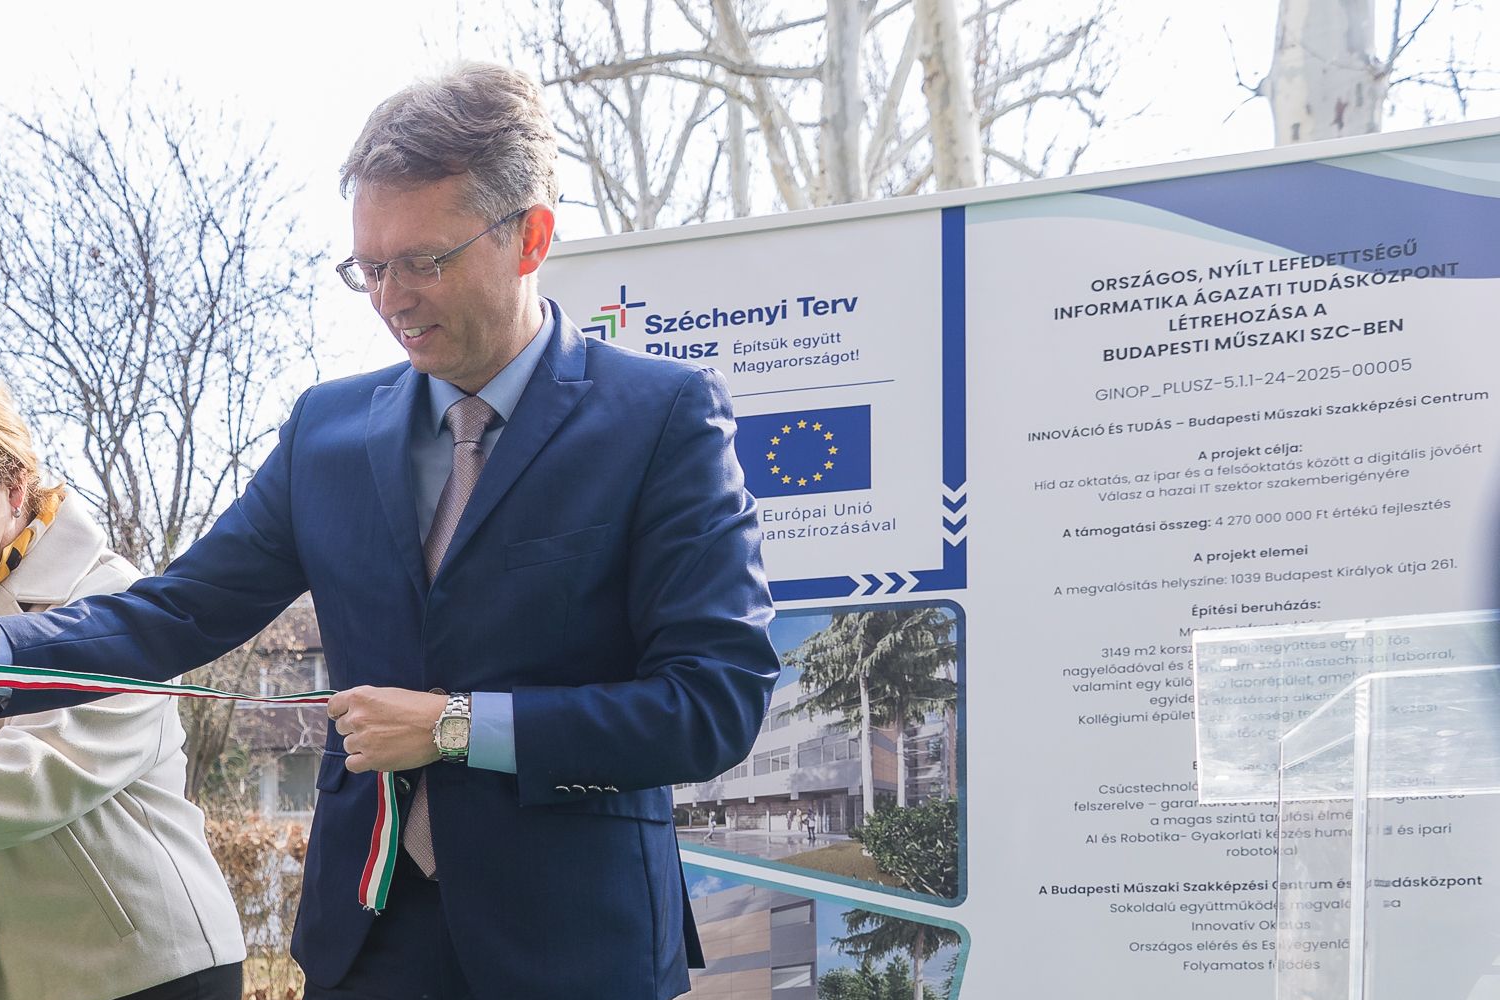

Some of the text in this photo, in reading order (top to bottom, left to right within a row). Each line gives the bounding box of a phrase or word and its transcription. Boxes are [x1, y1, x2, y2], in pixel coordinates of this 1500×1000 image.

[1090, 242, 1417, 292] ORSZÁGOS, NYÍLT LEFEDETTSÉGŰ
[1054, 262, 1459, 320] INFORMATIKA ÁGAZATI TUDÁSKÖZPONT
[644, 296, 858, 335] Széchenyi Terv
[1168, 302, 1328, 331] LÉTREHOZÁSA A
[732, 332, 842, 356] Építsük együtt
[1102, 318, 1404, 362] BUDAPESTI MŰSZAKI SZC-BEN
[732, 348, 859, 373] Magyarországot!
[1027, 391, 1489, 441] INNOVÁCIÓ ÉS TUDÁS Budapesti Műszaki Szakképzési Centrum
[1196, 442, 1303, 462] A projekt célja:
[1033, 443, 1483, 490] Híd az oktatás, az ipar és a felsőoktatás között a digitális jövőért
[1097, 467, 1410, 503] Válasz a hazai IT szektor szakemberigényére
[762, 500, 873, 522] Európai Unió
[1061, 498, 1451, 537] A támogatási összeg: 4 270 000 000 Ft értékű fejlesztés
[1192, 544, 1309, 564] A projekt elemei
[1053, 558, 1458, 596] A megvalósítás helyszíne: 1039 Budapest Királyok útja 261.
[1190, 598, 1321, 619] Építési beruházás:
[1100, 646, 1131, 659] 3149
[1133, 645, 1156, 657] m2
[1062, 661, 1164, 679] nagyelőadóval
[1168, 660, 1184, 671] és
[1071, 679, 1133, 692] valamint
[1135, 679, 1162, 692] egy
[1077, 711, 1149, 726] Kollégiumi
[1151, 709, 1196, 724] épület
[1073, 799, 1145, 811] felszerelve
[1149, 817, 1160, 825] a
[1162, 815, 1213, 828] magas
[1215, 811, 1257, 824] szintű
[1084, 834, 1098, 844] AI
[1100, 832, 1117, 843] és
[1119, 831, 1188, 843] Robotika-
[1190, 828, 1262, 843] Gyakorlati
[1396, 824, 1415, 835] és
[1417, 822, 1452, 837] ipari
[1225, 845, 1298, 857] robotokal
[1037, 885, 1048, 894] A
[1050, 882, 1120, 896] Budapesti
[1122, 881, 1180, 893] Műszaki
[1182, 879, 1269, 894] Szakképzési
[1109, 900, 1177, 913] Sokoldalú
[1190, 919, 1256, 931] Innovatív
[1128, 940, 1194, 954] Országos
[1195, 939, 1239, 951] elérés
[1240, 938, 1259, 950] és
[1182, 959, 1264, 973] Folyamatos
